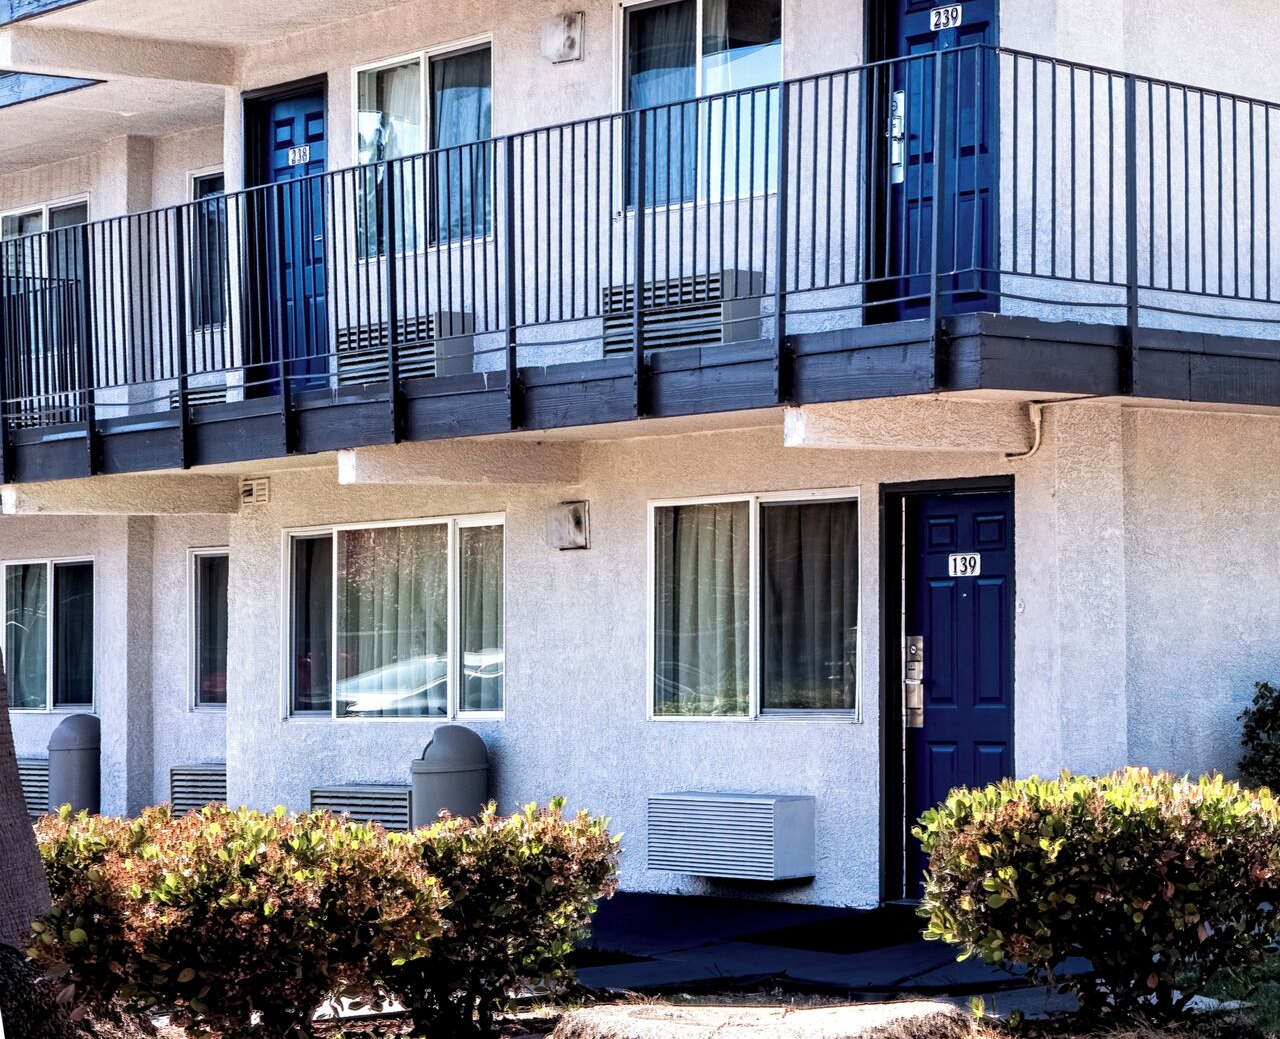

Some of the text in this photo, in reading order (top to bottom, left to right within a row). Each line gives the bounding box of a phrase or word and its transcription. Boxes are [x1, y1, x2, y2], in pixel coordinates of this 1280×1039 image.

[933, 7, 959, 30] 239
[291, 147, 308, 164] 238
[952, 556, 977, 576] 139
